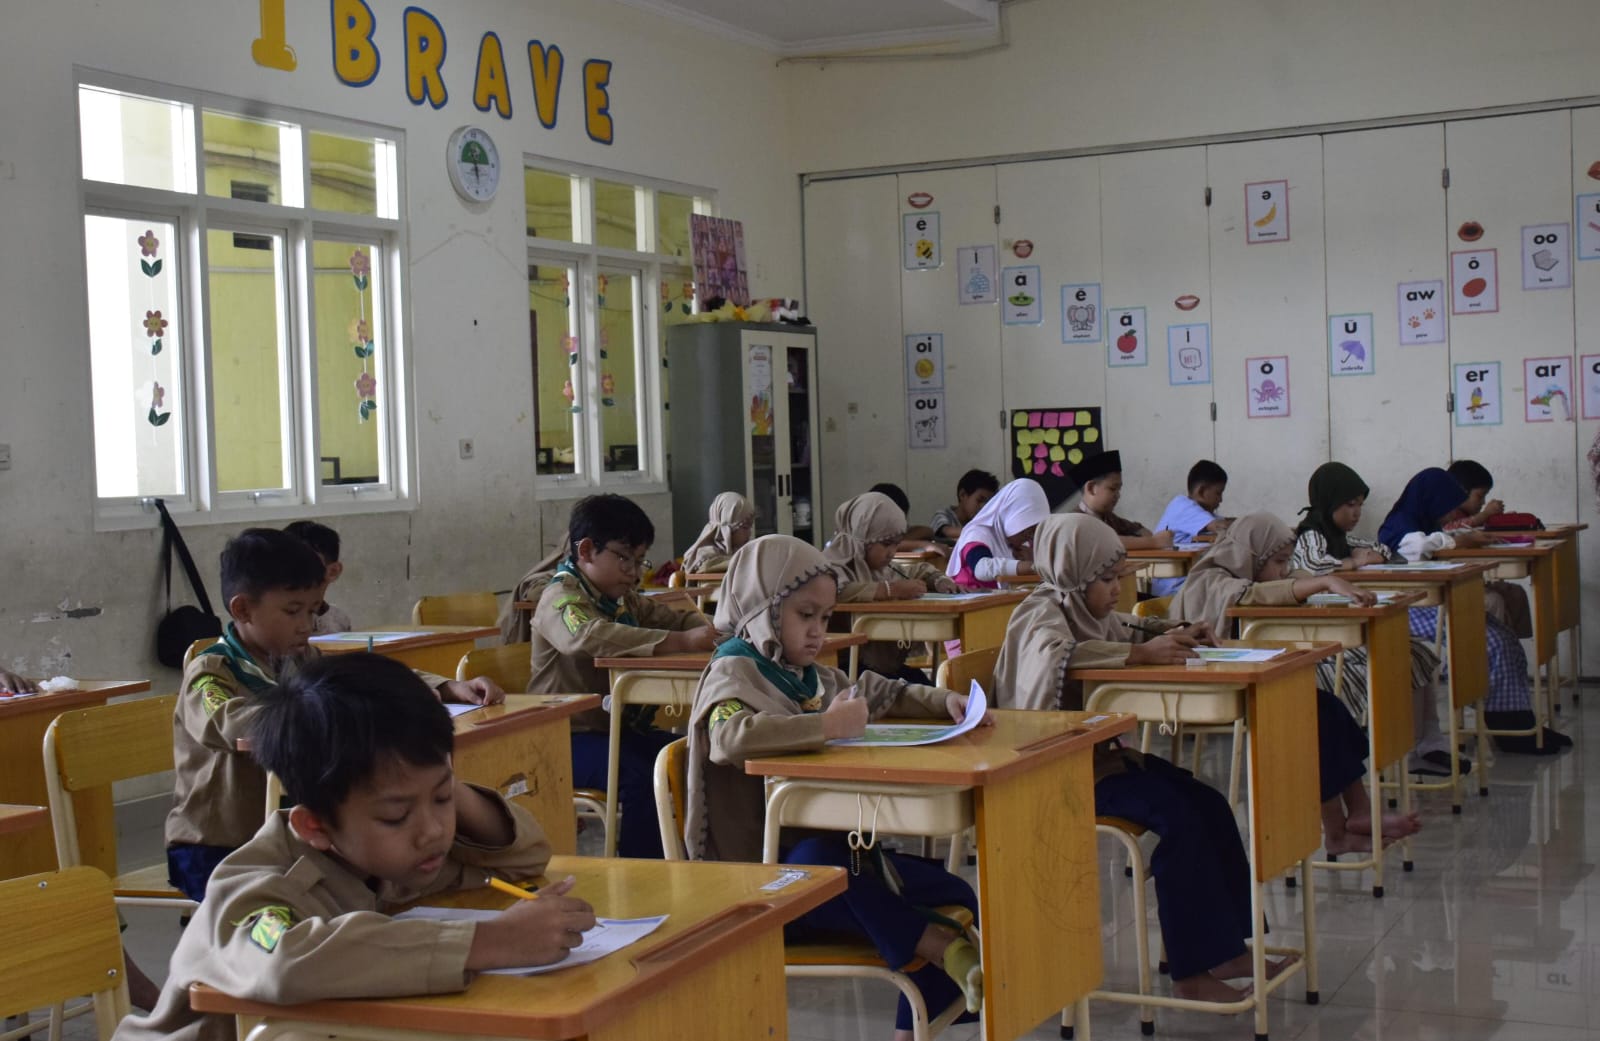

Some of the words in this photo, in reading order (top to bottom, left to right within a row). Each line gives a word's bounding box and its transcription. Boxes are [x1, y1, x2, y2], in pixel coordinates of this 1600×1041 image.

[330, 0, 613, 146] BRAVE
[1533, 233, 1558, 245] oo
[1406, 290, 1435, 302] aw
[916, 336, 932, 353] oi
[1465, 369, 1489, 382] er
[1535, 364, 1562, 378] ar
[915, 398, 937, 410] ou
